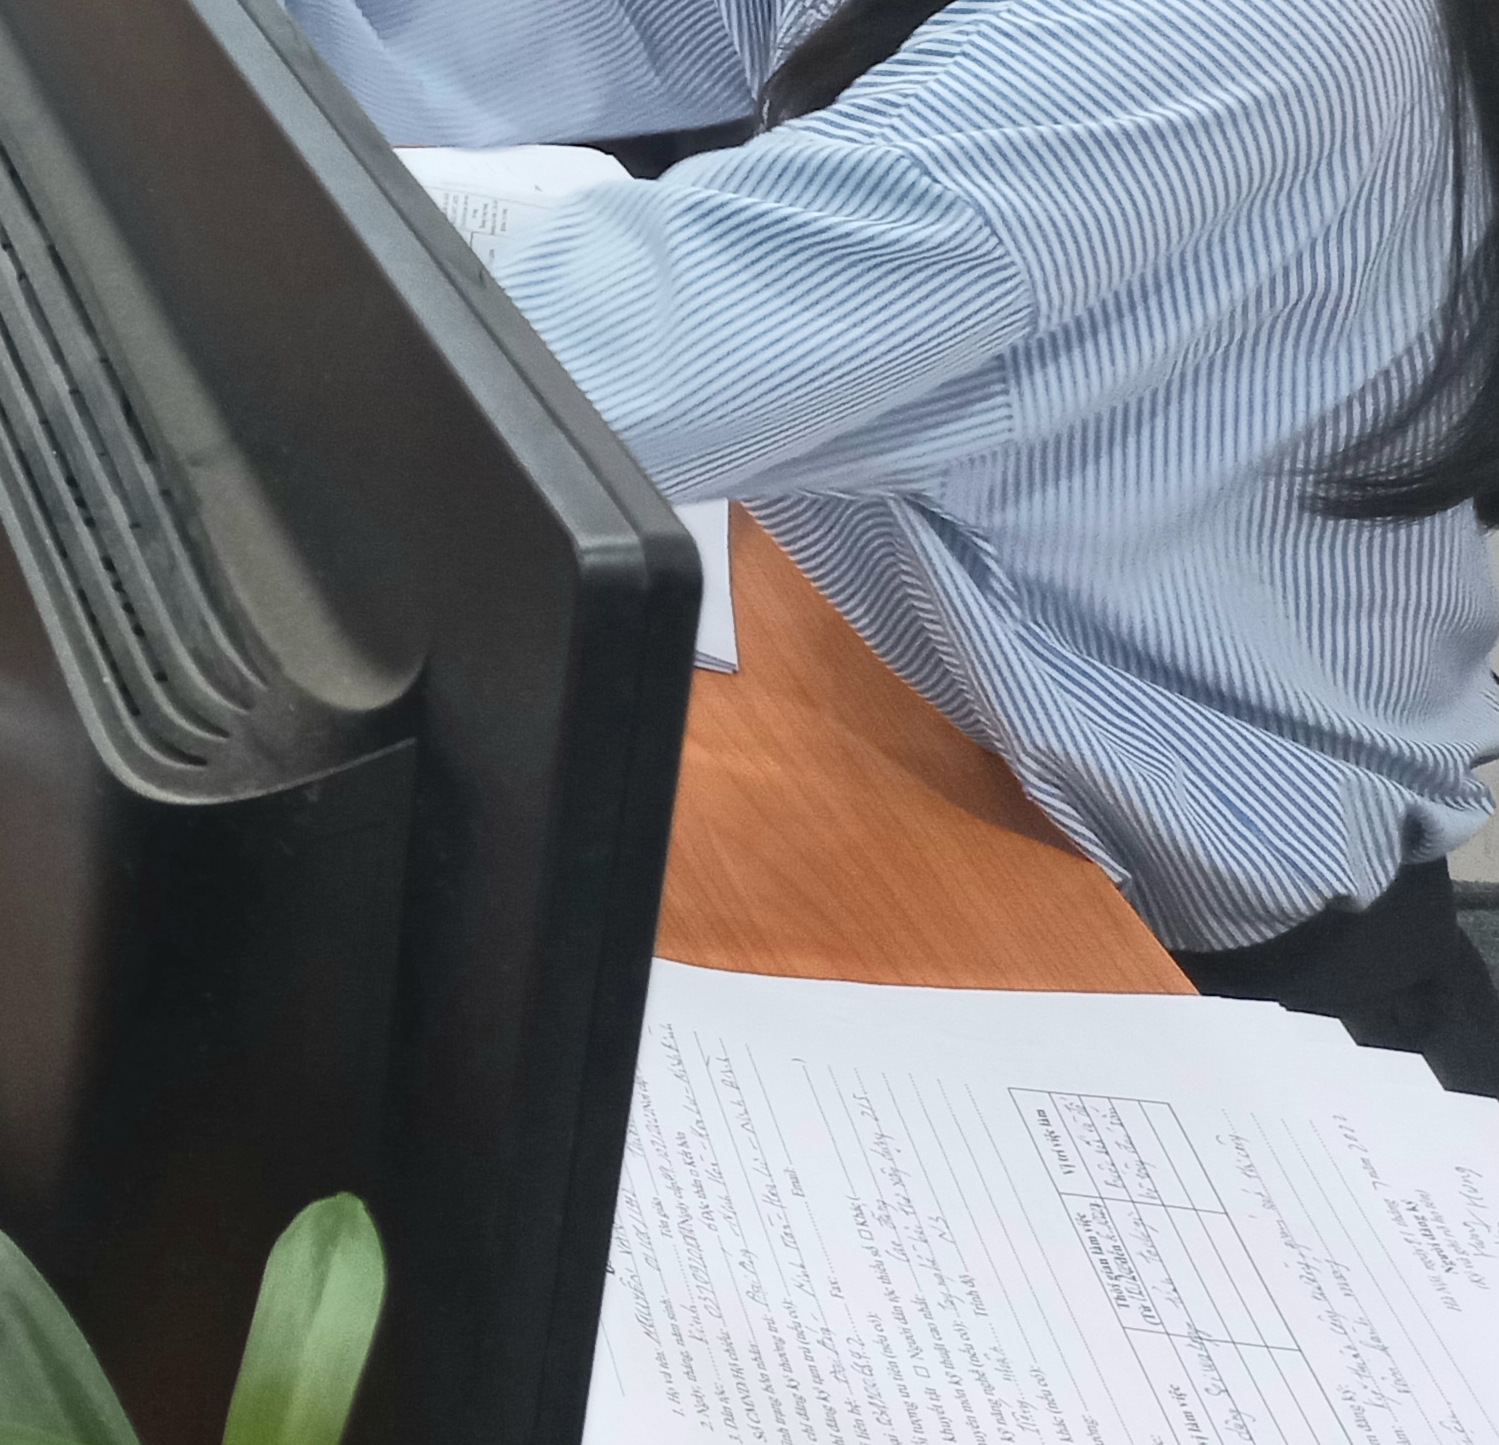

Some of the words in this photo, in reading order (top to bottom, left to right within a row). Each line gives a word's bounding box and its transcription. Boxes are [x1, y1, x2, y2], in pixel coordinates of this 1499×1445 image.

[1037, 1110, 1050, 1126] làm
[1044, 1129, 1061, 1147] việc
[1052, 1150, 1068, 1161] trí
[1060, 1164, 1074, 1174] Vị
[1360, 1157, 1379, 1179] năm
[784, 1167, 805, 1197] Email:
[1406, 1201, 1418, 1211] ký
[1075, 1213, 1092, 1232] việc
[1414, 1215, 1436, 1240] đăng
[862, 1246, 881, 1257] số
[1088, 1236, 1104, 1255] làm
[1428, 1243, 1457, 1274] Người
[869, 1260, 891, 1284] thiểu
[1099, 1259, 1119, 1281] gian
[828, 1276, 844, 1299] Fax:
[959, 1275, 975, 1288] độ
[884, 1287, 899, 1302] tộc
[966, 1290, 988, 1316] Trình
[1108, 1283, 1129, 1307] Thời
[661, 1296, 677, 1321] sinh:
[892, 1306, 908, 1325] dân
[911, 1294, 933, 1320] nhất:
[867, 1312, 883, 1332] có):
[928, 1323, 942, 1341] cao
[953, 1321, 970, 1341] có):
[671, 1323, 685, 1346] năm
[787, 1321, 810, 1345] (nếu
[899, 1327, 923, 1360] Người
[772, 1335, 793, 1373] thường
[799, 1347, 814, 1362] trú
[873, 1335, 896, 1358] (nếu
[934, 1343, 954, 1369] thuật
[959, 1343, 984, 1367] (nếu
[655, 1349, 669, 1369] tên:
[661, 1372, 673, 1383] và
[808, 1365, 823, 1385] tạm
[887, 1361, 903, 1381] tiên
[945, 1372, 962, 1386] kỹ
[1030, 1366, 1048, 1387] có):
[760, 1373, 774, 1394] hôn
[784, 1376, 800, 1390] ký
[897, 1384, 910, 1398] ưu
[968, 1370, 995, 1396] nghề
[1337, 1385, 1355, 1401] ký:
[666, 1388, 680, 1404] Họ
[691, 1386, 709, 1417] Ngày,
[813, 1387, 829, 1402] ký
[925, 1387, 940, 1401] tật
[955, 1389, 973, 1413] môn
[1036, 1390, 1062, 1414] (nếu
[1169, 1385, 1187, 1407] việc
[769, 1396, 786, 1425] trạng
[793, 1393, 809, 1421] đăng
[844, 1398, 861, 1416] hệ:
[904, 1401, 924, 1434] tượng
[988, 1399, 1006, 1425] năng
[700, 1421, 713, 1431] 2.
[721, 1406, 738, 1430] Dân
[823, 1405, 840, 1432] đăng
[927, 1404, 956, 1442] khuyết
[1183, 1411, 1201, 1432] làm
[1350, 1405, 1372, 1432] đăng
[853, 1419, 870, 1440] liên
[997, 1428, 1014, 1442] kỹ
[1053, 1416, 1073, 1442] khác
